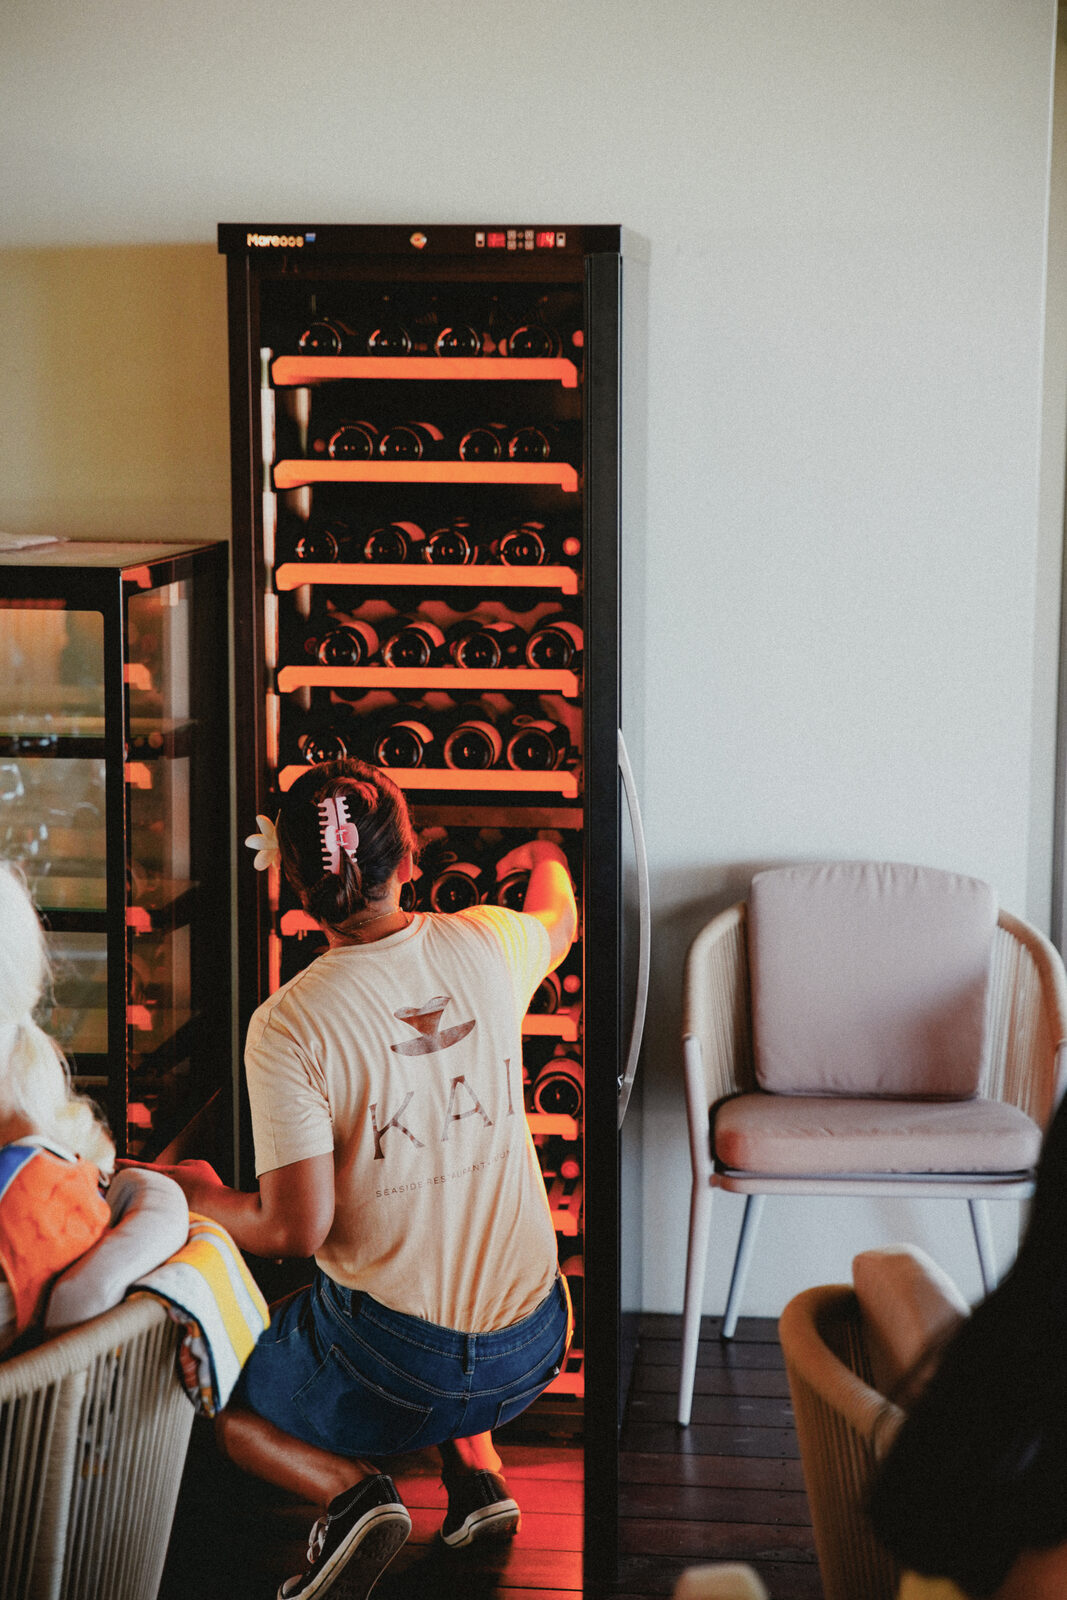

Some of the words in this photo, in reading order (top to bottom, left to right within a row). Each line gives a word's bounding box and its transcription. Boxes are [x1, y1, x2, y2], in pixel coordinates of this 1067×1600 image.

[368, 1057, 515, 1160] KAI
[375, 1180, 423, 1198] SEASIDE
[426, 1162, 485, 1186] RESAURANT
